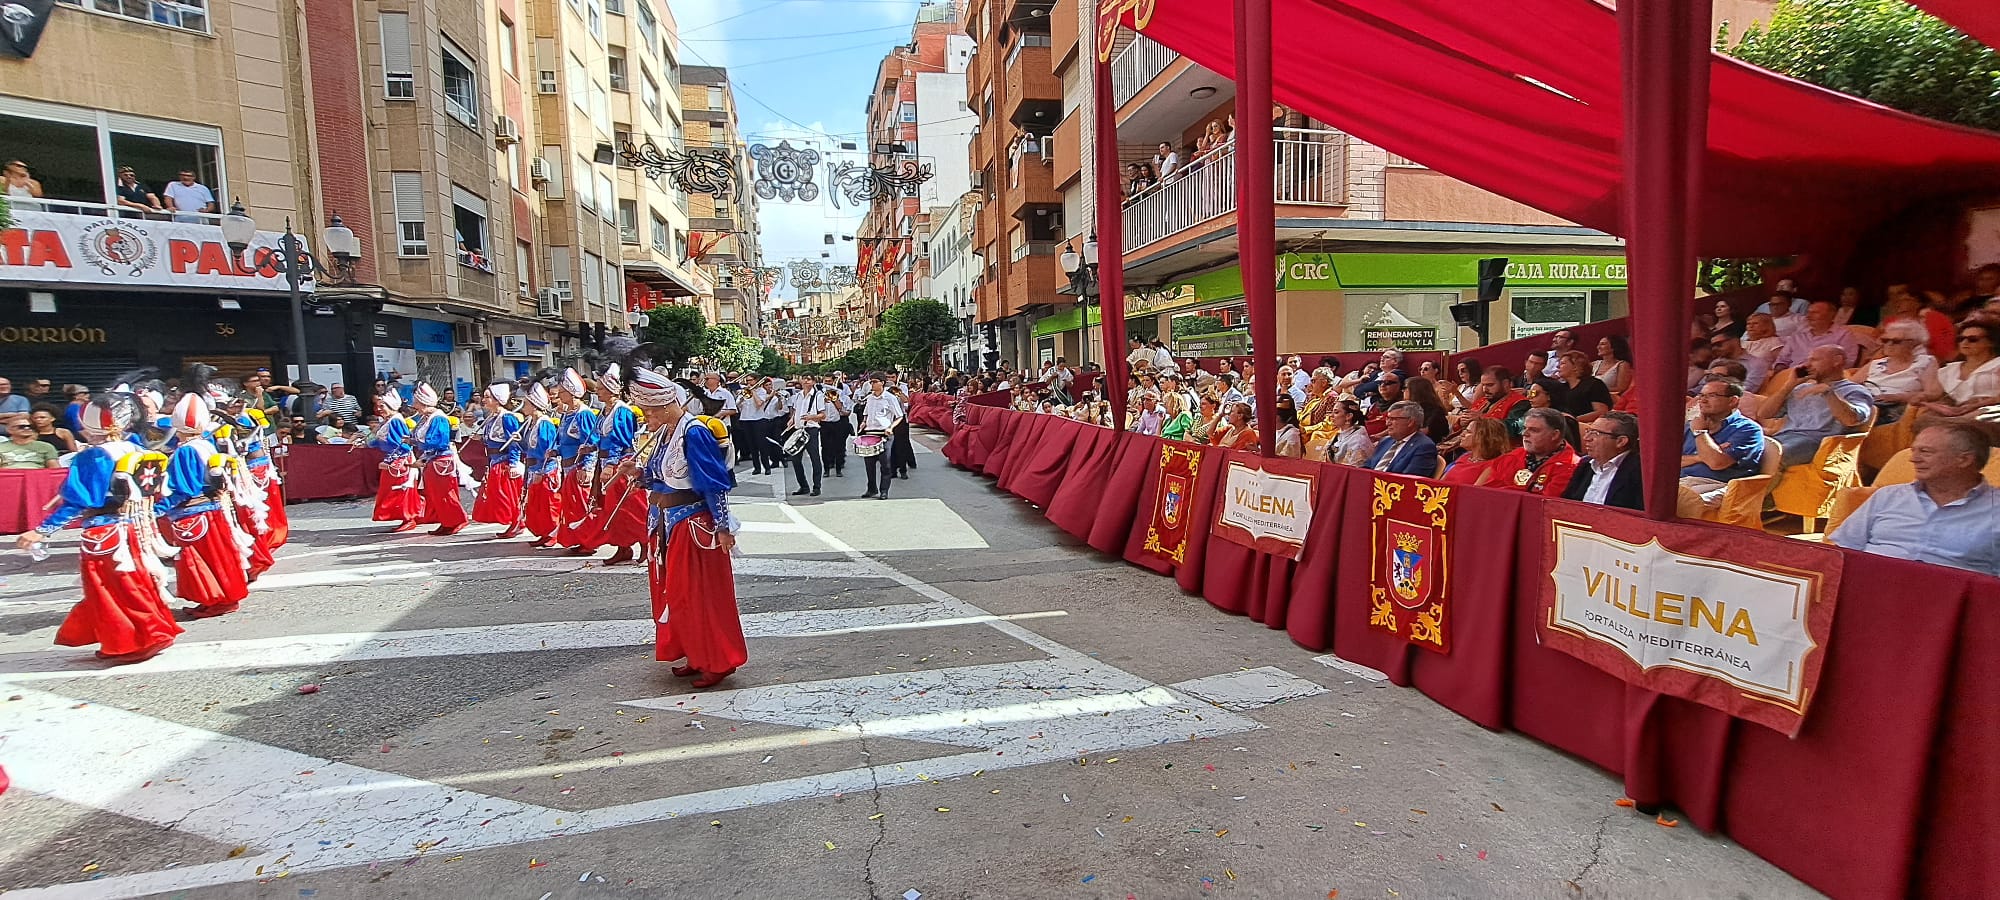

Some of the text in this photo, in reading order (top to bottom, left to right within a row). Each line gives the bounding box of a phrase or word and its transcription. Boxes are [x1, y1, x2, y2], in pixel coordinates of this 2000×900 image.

[84, 219, 149, 237] PATA PALO
[0, 228, 279, 279] TA PALO
[1290, 263, 1330, 280] CRC
[1504, 263, 1545, 280] CAJA
[1548, 263, 1601, 280] RURAL
[215, 321, 235, 336] 36
[1367, 330, 1434, 339] REMUNERAMOS TU
[1366, 338, 1433, 347] COANZA Y LA
[1234, 486, 1296, 519] VILLENA
[1582, 566, 1760, 647] VILLENA
[1584, 609, 1752, 672] FORTALEZA MEDITERRÁNEA
